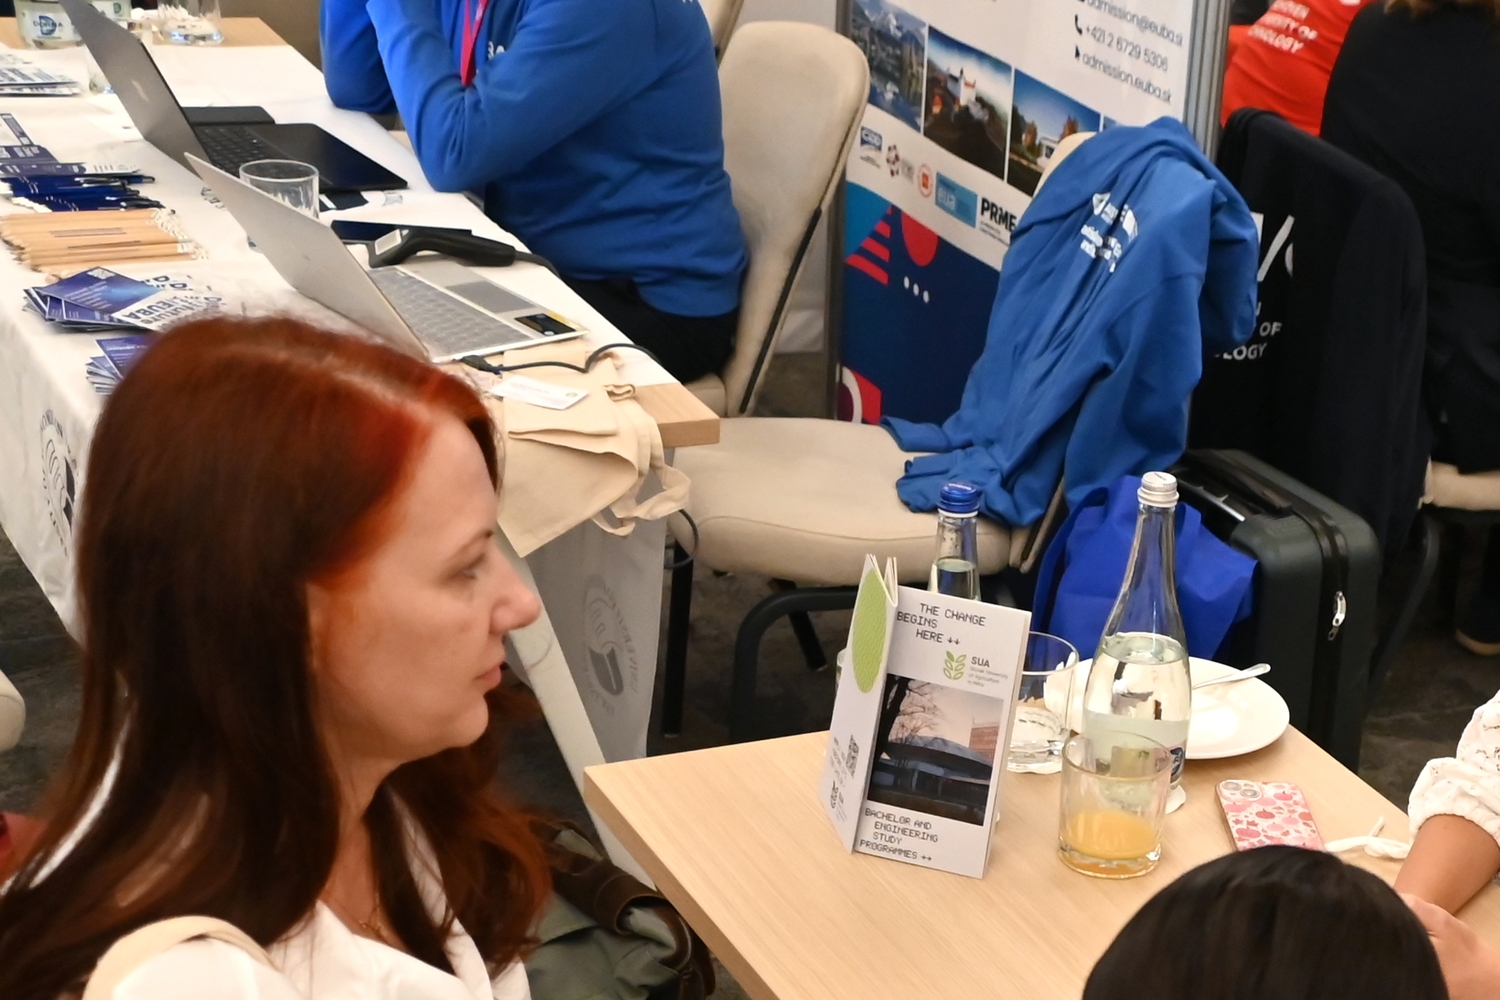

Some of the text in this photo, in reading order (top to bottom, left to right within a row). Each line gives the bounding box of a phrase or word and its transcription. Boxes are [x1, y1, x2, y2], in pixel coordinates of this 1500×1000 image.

[1107, 33, 1114, 48] 2
[1116, 36, 1141, 60] 6729
[1144, 48, 1168, 72] 5306
[1082, 53, 1171, 105] admission.euba.sk
[1259, 321, 1282, 337] OF
[896, 611, 938, 629] BEGINS
[920, 602, 987, 627] THE CHANGE
[916, 629, 944, 644] HERE
[971, 656, 990, 668] SUA
[865, 807, 932, 830] BACHELOR AND
[873, 831, 902, 845] STUDY
[874, 821, 939, 843] ENGINEERING
[859, 839, 918, 860] PROGRAMMES
